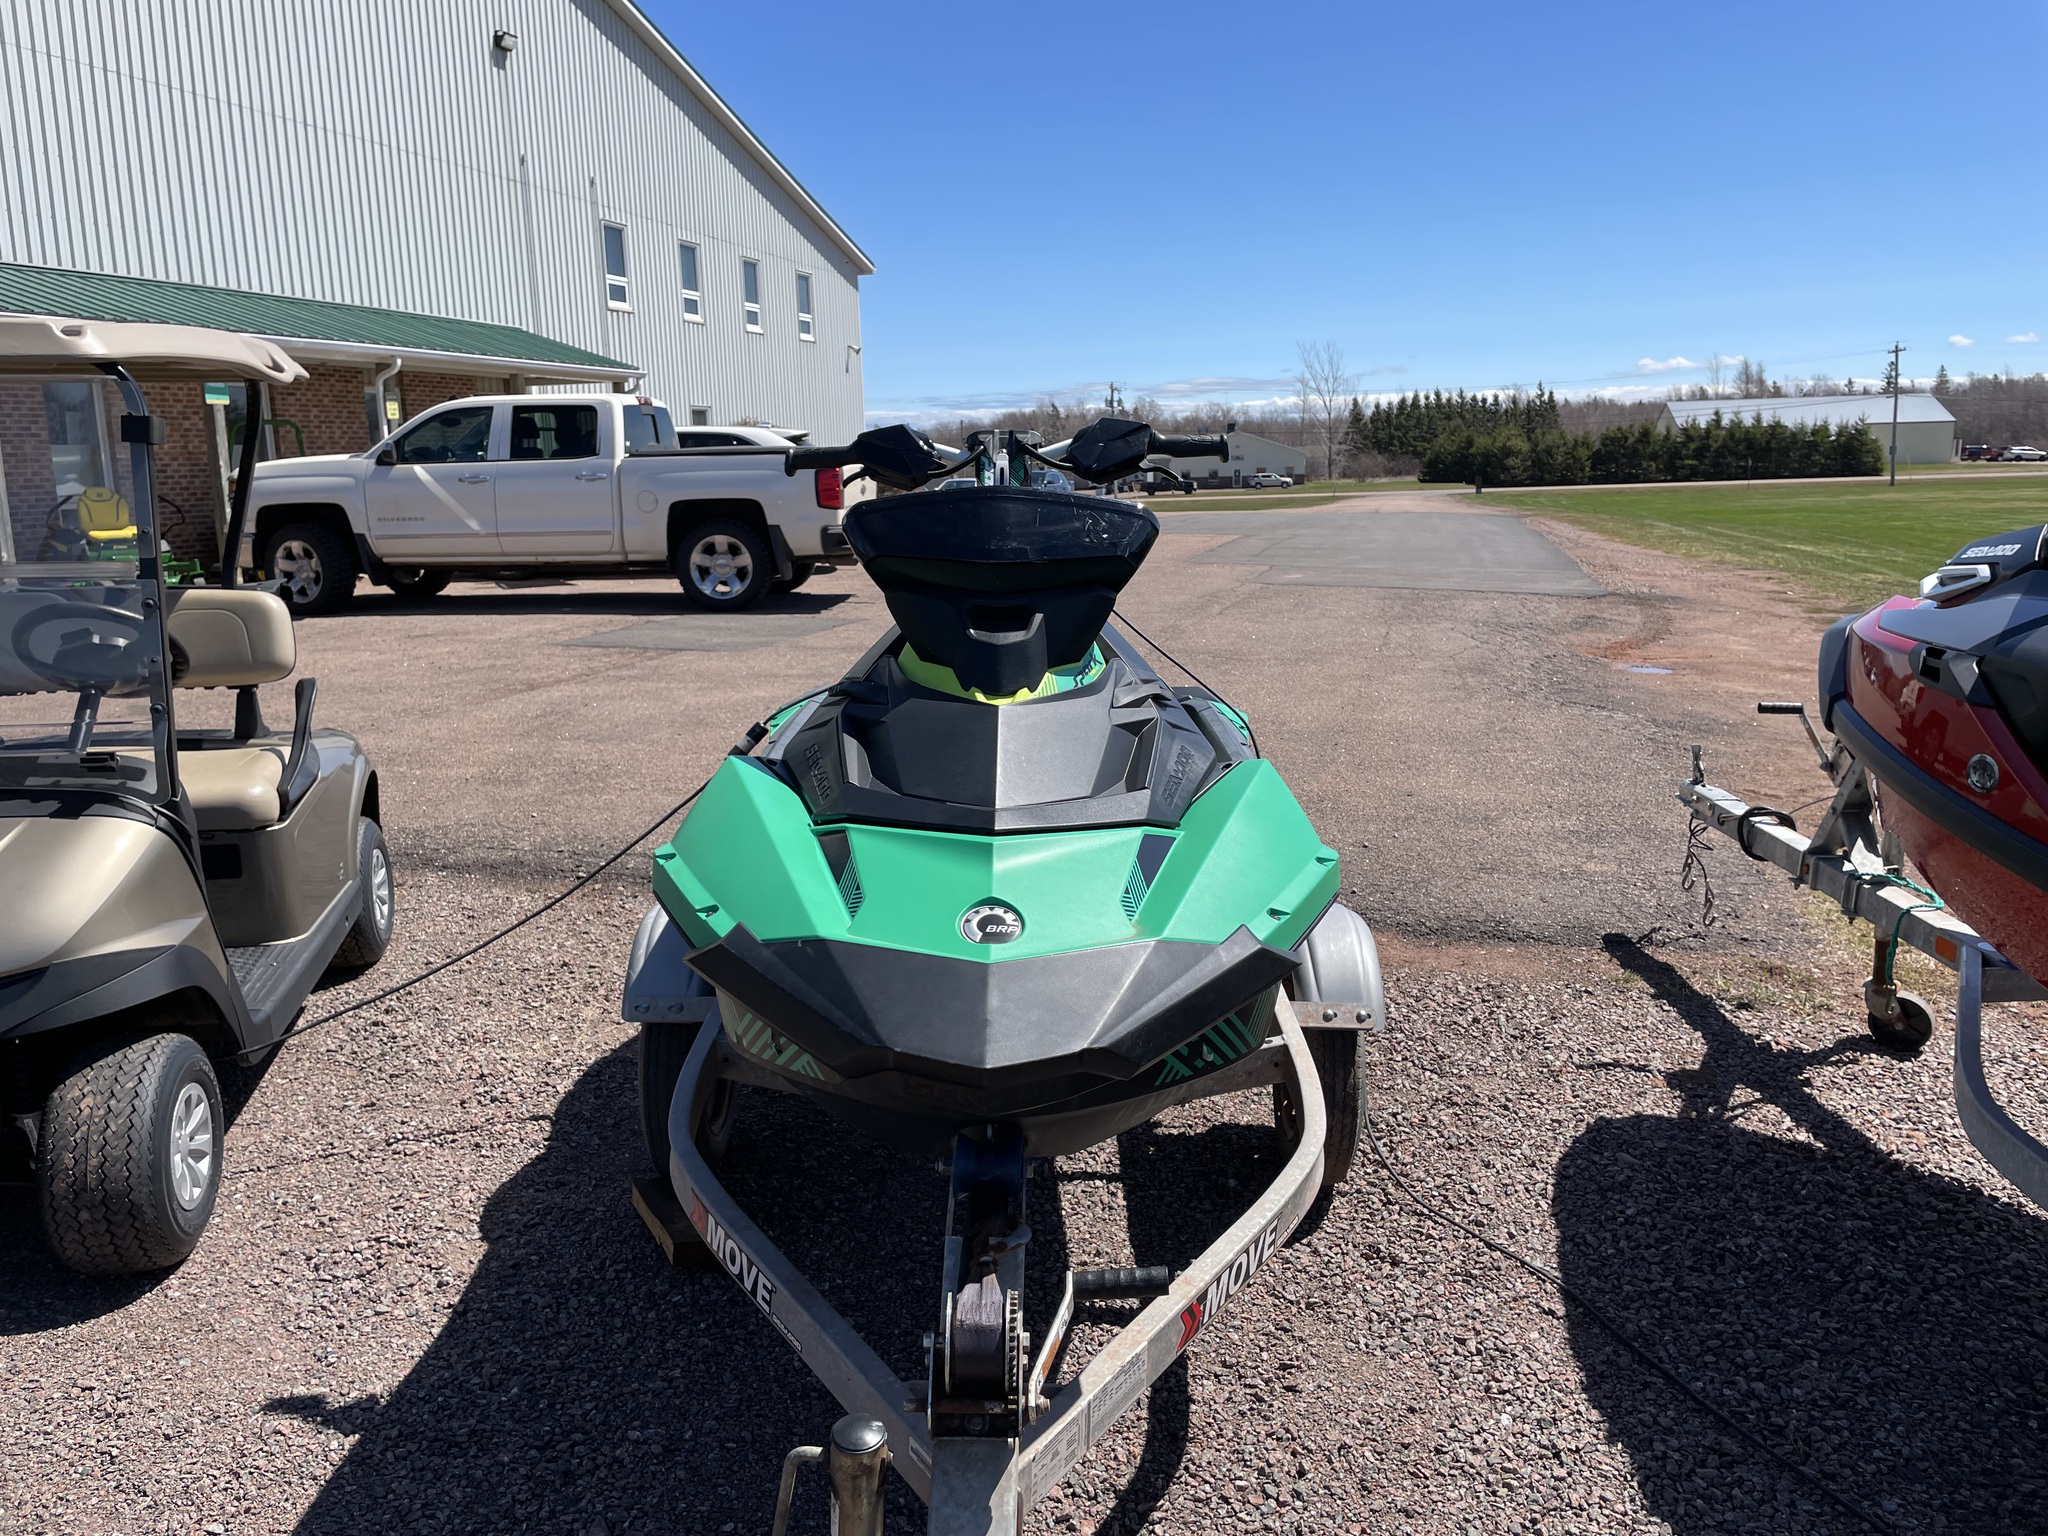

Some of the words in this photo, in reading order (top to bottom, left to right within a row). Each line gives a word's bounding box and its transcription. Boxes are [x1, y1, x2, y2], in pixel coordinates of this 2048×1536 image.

[985, 924, 1019, 933] BRP
[706, 1212, 773, 1314] MOVE
[1202, 1217, 1279, 1324] MOVE
